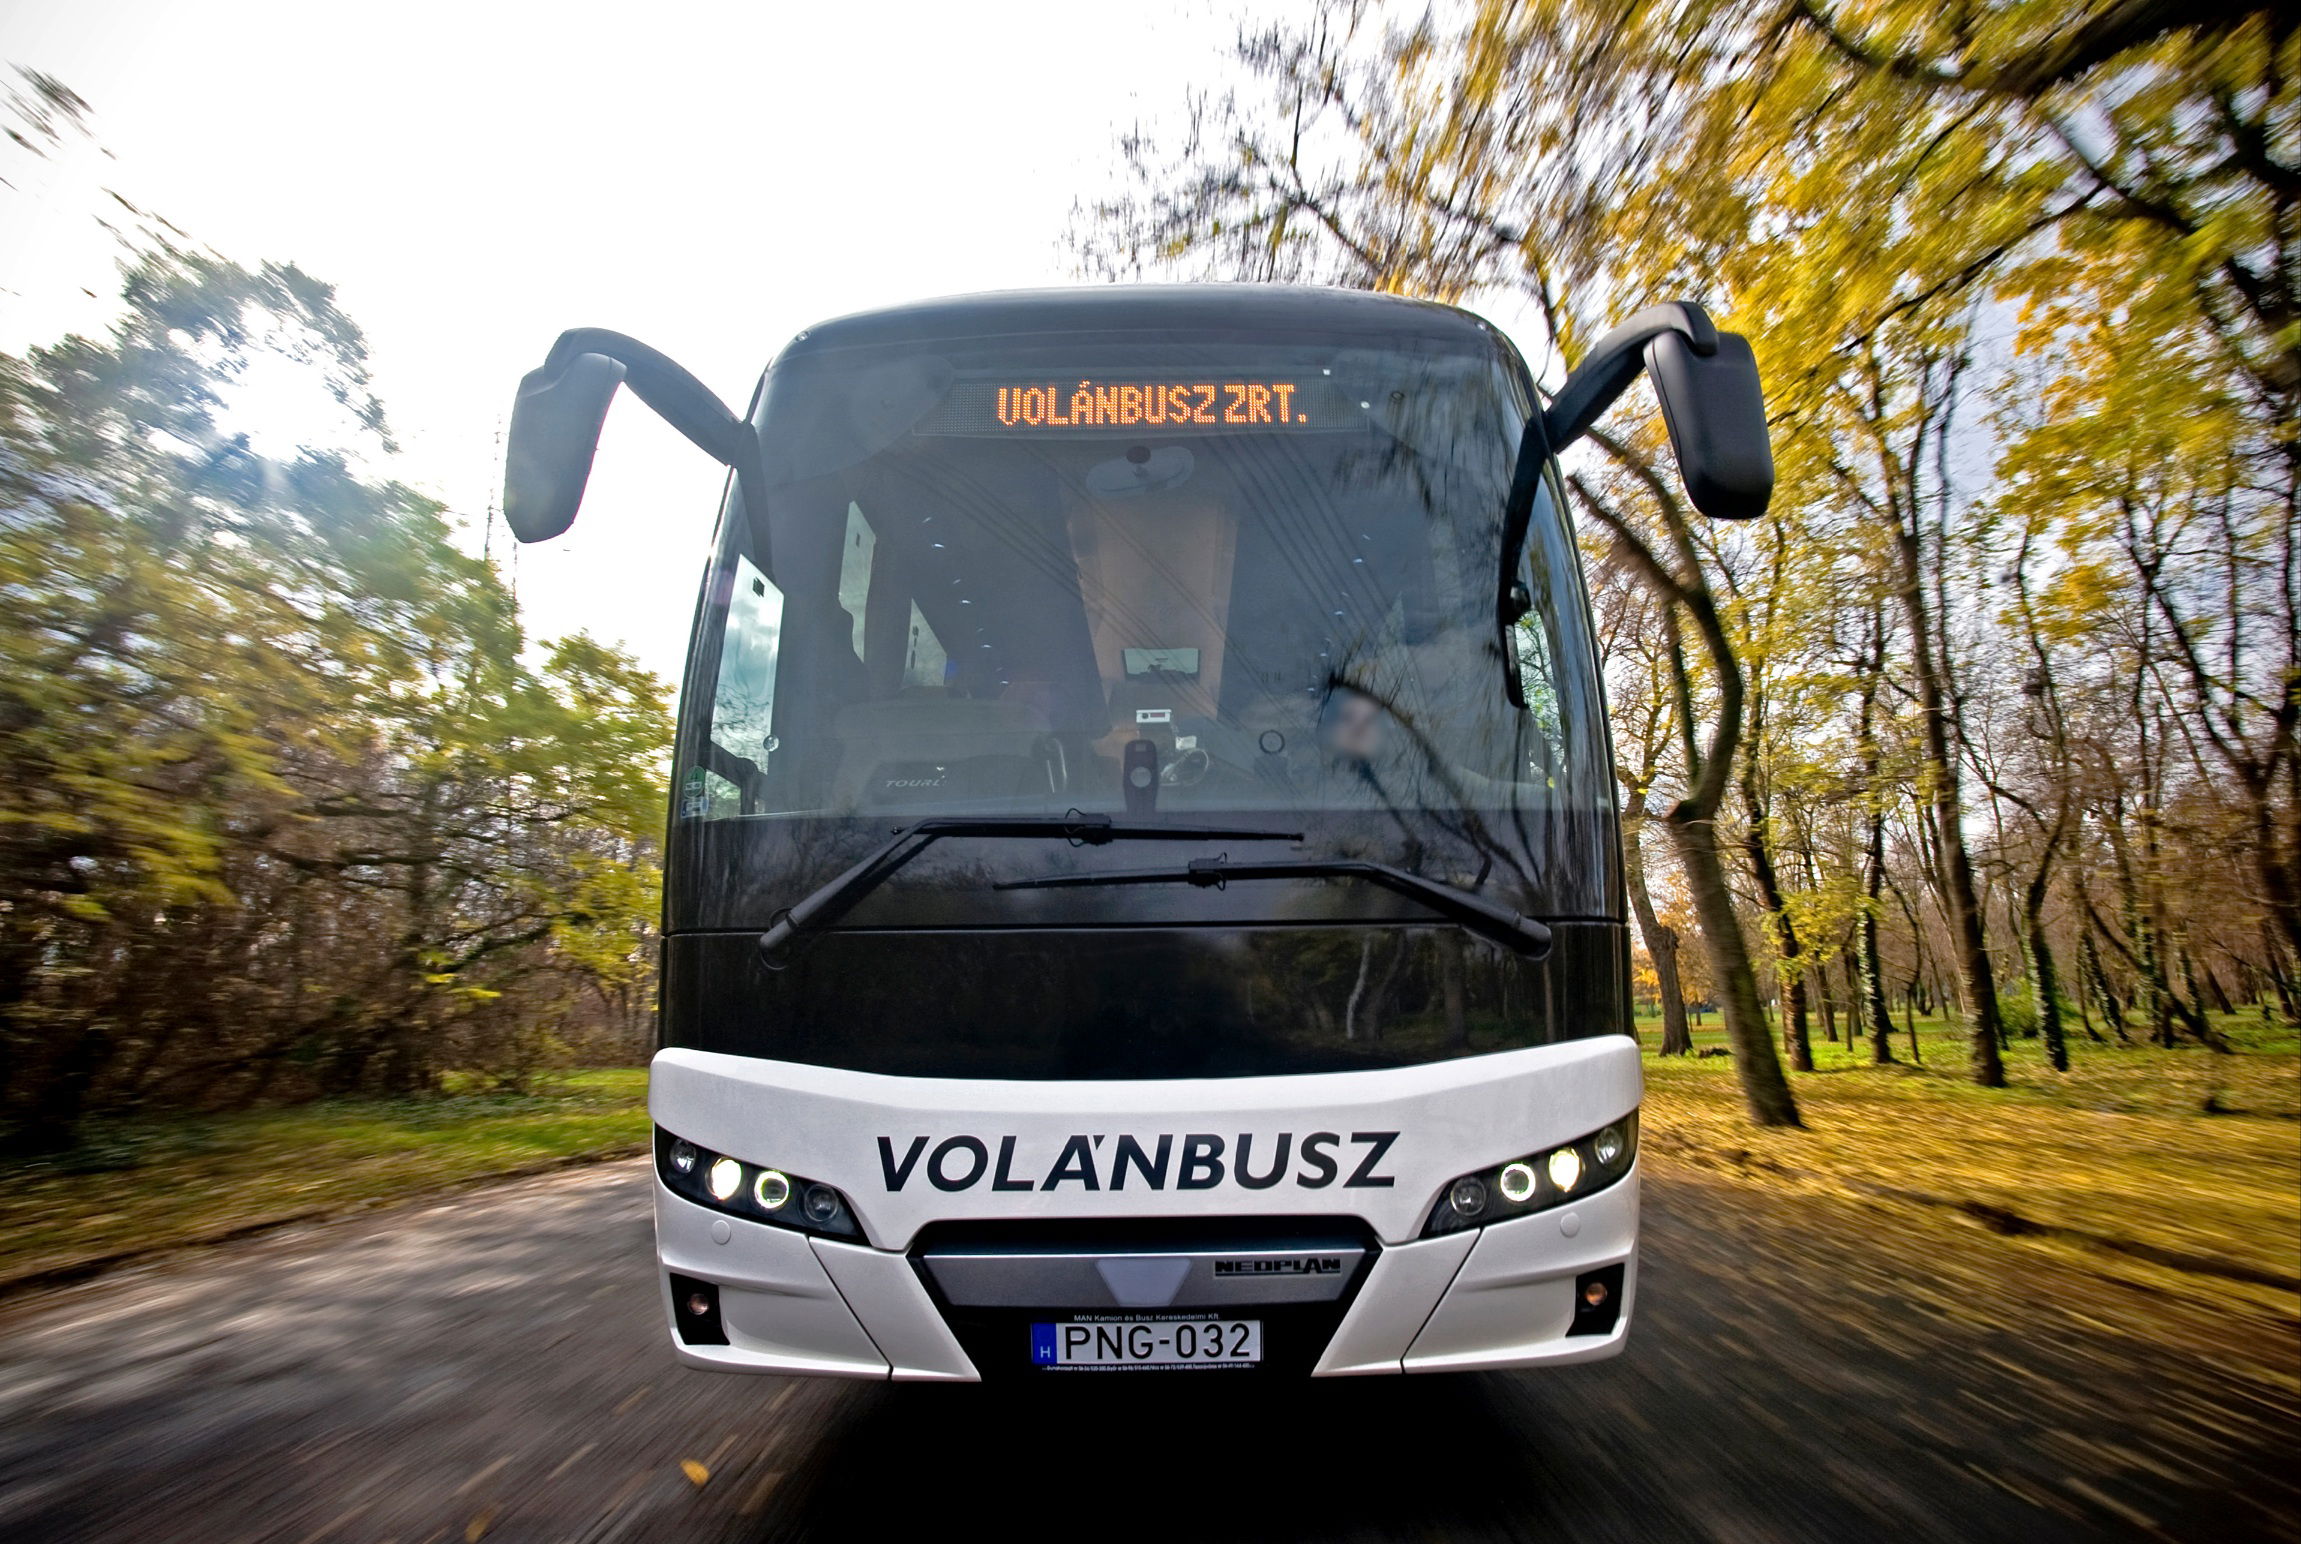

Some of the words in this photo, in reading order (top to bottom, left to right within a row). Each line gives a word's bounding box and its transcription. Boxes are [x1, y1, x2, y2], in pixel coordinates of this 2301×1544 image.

[998, 379, 1216, 426] VOLÁNBUSZ
[1223, 383, 1308, 424] ZRT.
[876, 1131, 1401, 1193] VOLÁNBUSZ
[1214, 1257, 1341, 1276] NEOPLAN
[1073, 1314, 1092, 1322] MAN
[1094, 1314, 1122, 1322] Kamion
[1040, 1345, 1051, 1359] H
[1064, 1323, 1251, 1360] PNG-032
